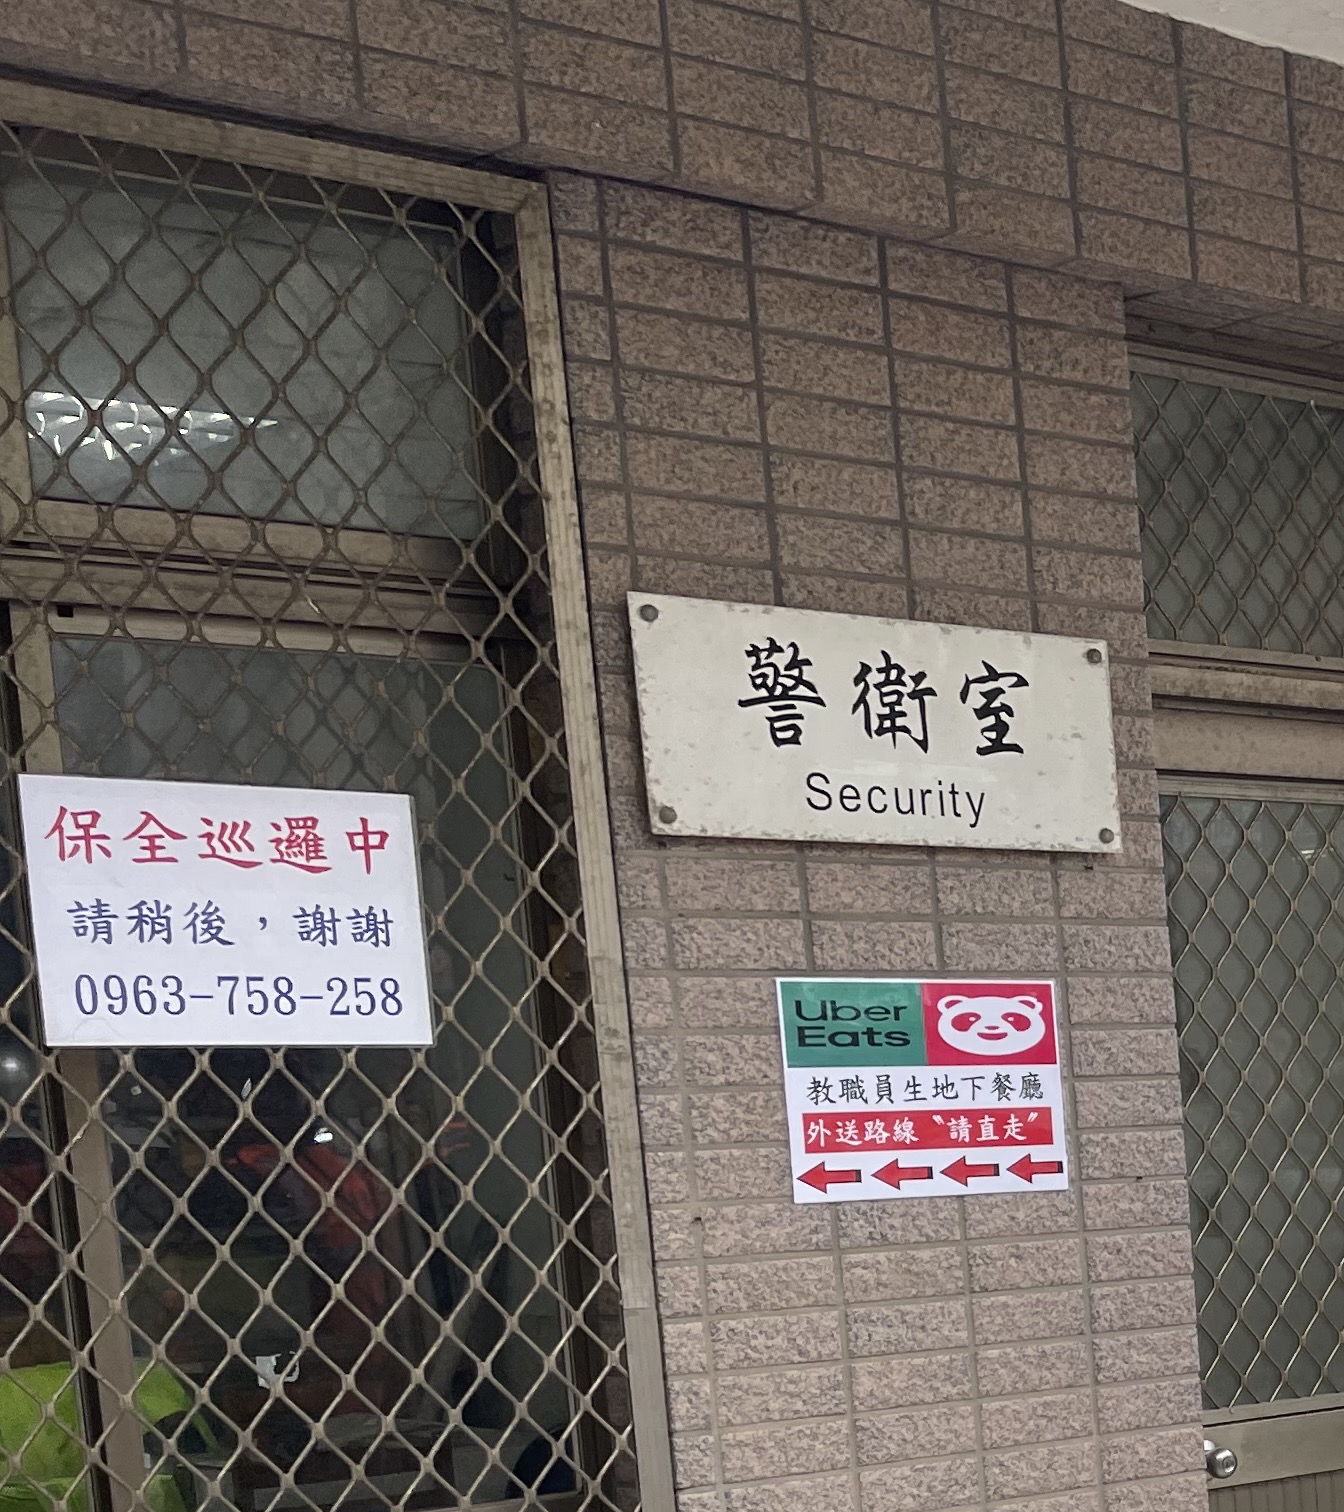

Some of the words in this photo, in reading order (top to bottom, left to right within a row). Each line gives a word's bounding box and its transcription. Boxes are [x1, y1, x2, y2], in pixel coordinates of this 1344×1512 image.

[738, 636, 1030, 756] 警衛室
[805, 772, 985, 828] Security
[45, 804, 391, 876] 保全巡邏中
[66, 897, 394, 948] 請稍後，謝謝
[74, 974, 404, 1016] 0963-758-258
[795, 999, 908, 1022] Uber
[797, 1025, 911, 1048] Eats
[806, 1071, 1044, 1106] 教職員生地下餐廳
